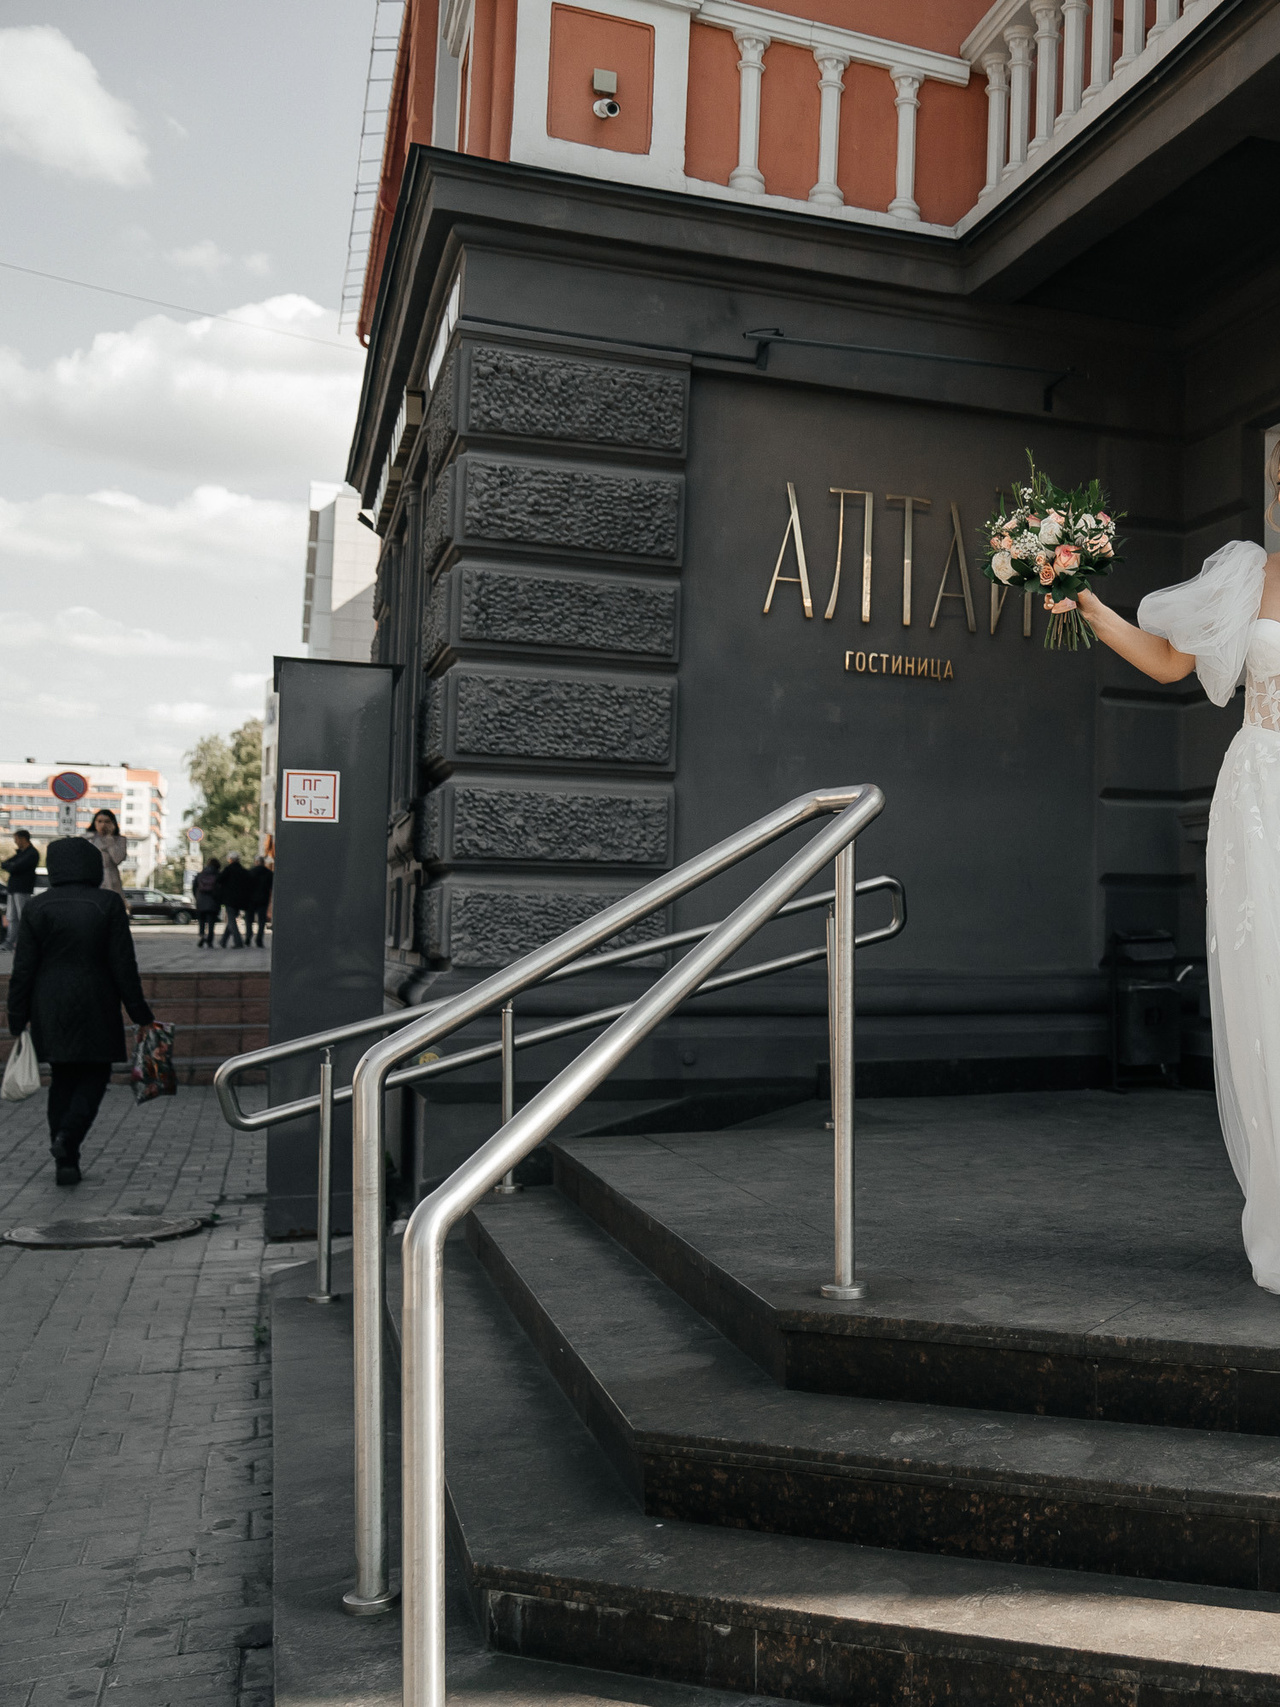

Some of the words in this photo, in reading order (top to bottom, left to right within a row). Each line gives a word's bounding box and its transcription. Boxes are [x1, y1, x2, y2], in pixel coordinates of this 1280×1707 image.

[845, 650, 954, 681] ГОСТИНИЦА
[302, 778, 321, 791] ПГ
[296, 798, 306, 806] 10
[313, 807, 327, 816] 37
